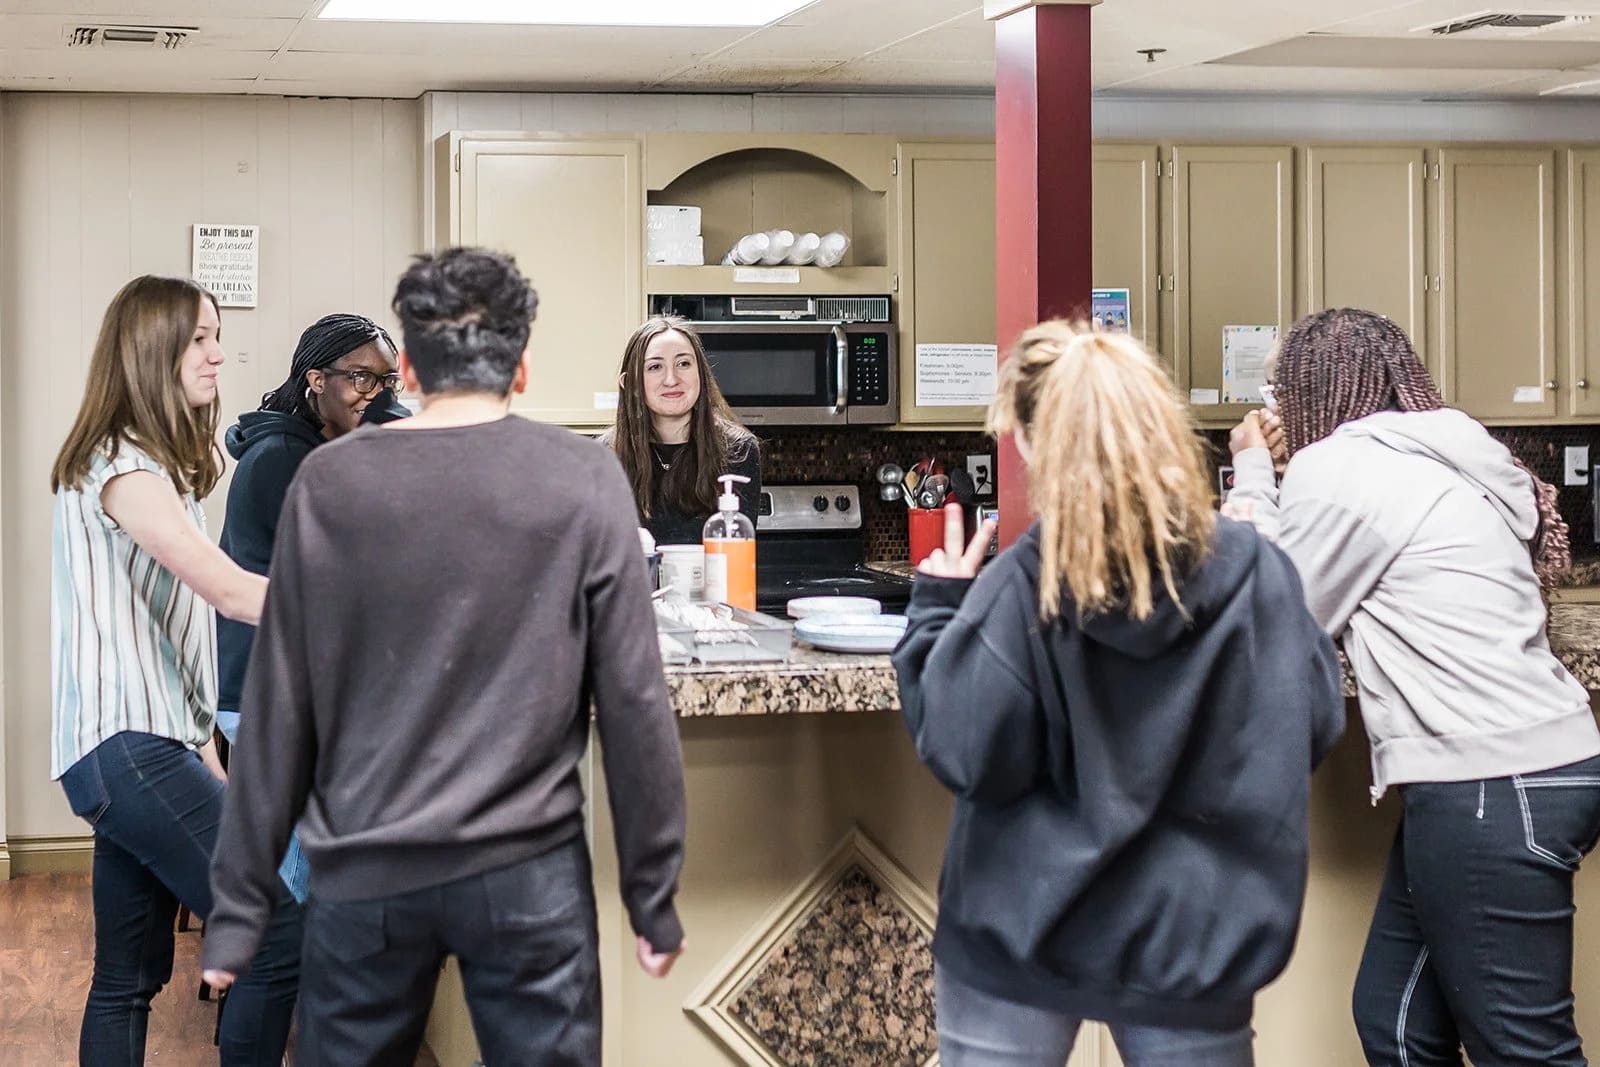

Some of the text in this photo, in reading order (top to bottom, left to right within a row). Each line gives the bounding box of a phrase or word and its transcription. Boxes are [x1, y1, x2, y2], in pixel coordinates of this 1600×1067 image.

[200, 227, 254, 238] ENJOY THIS DAY
[200, 239, 254, 251] Be present
[199, 262, 253, 271] Show gratitude
[211, 282, 253, 291] FEARLESS
